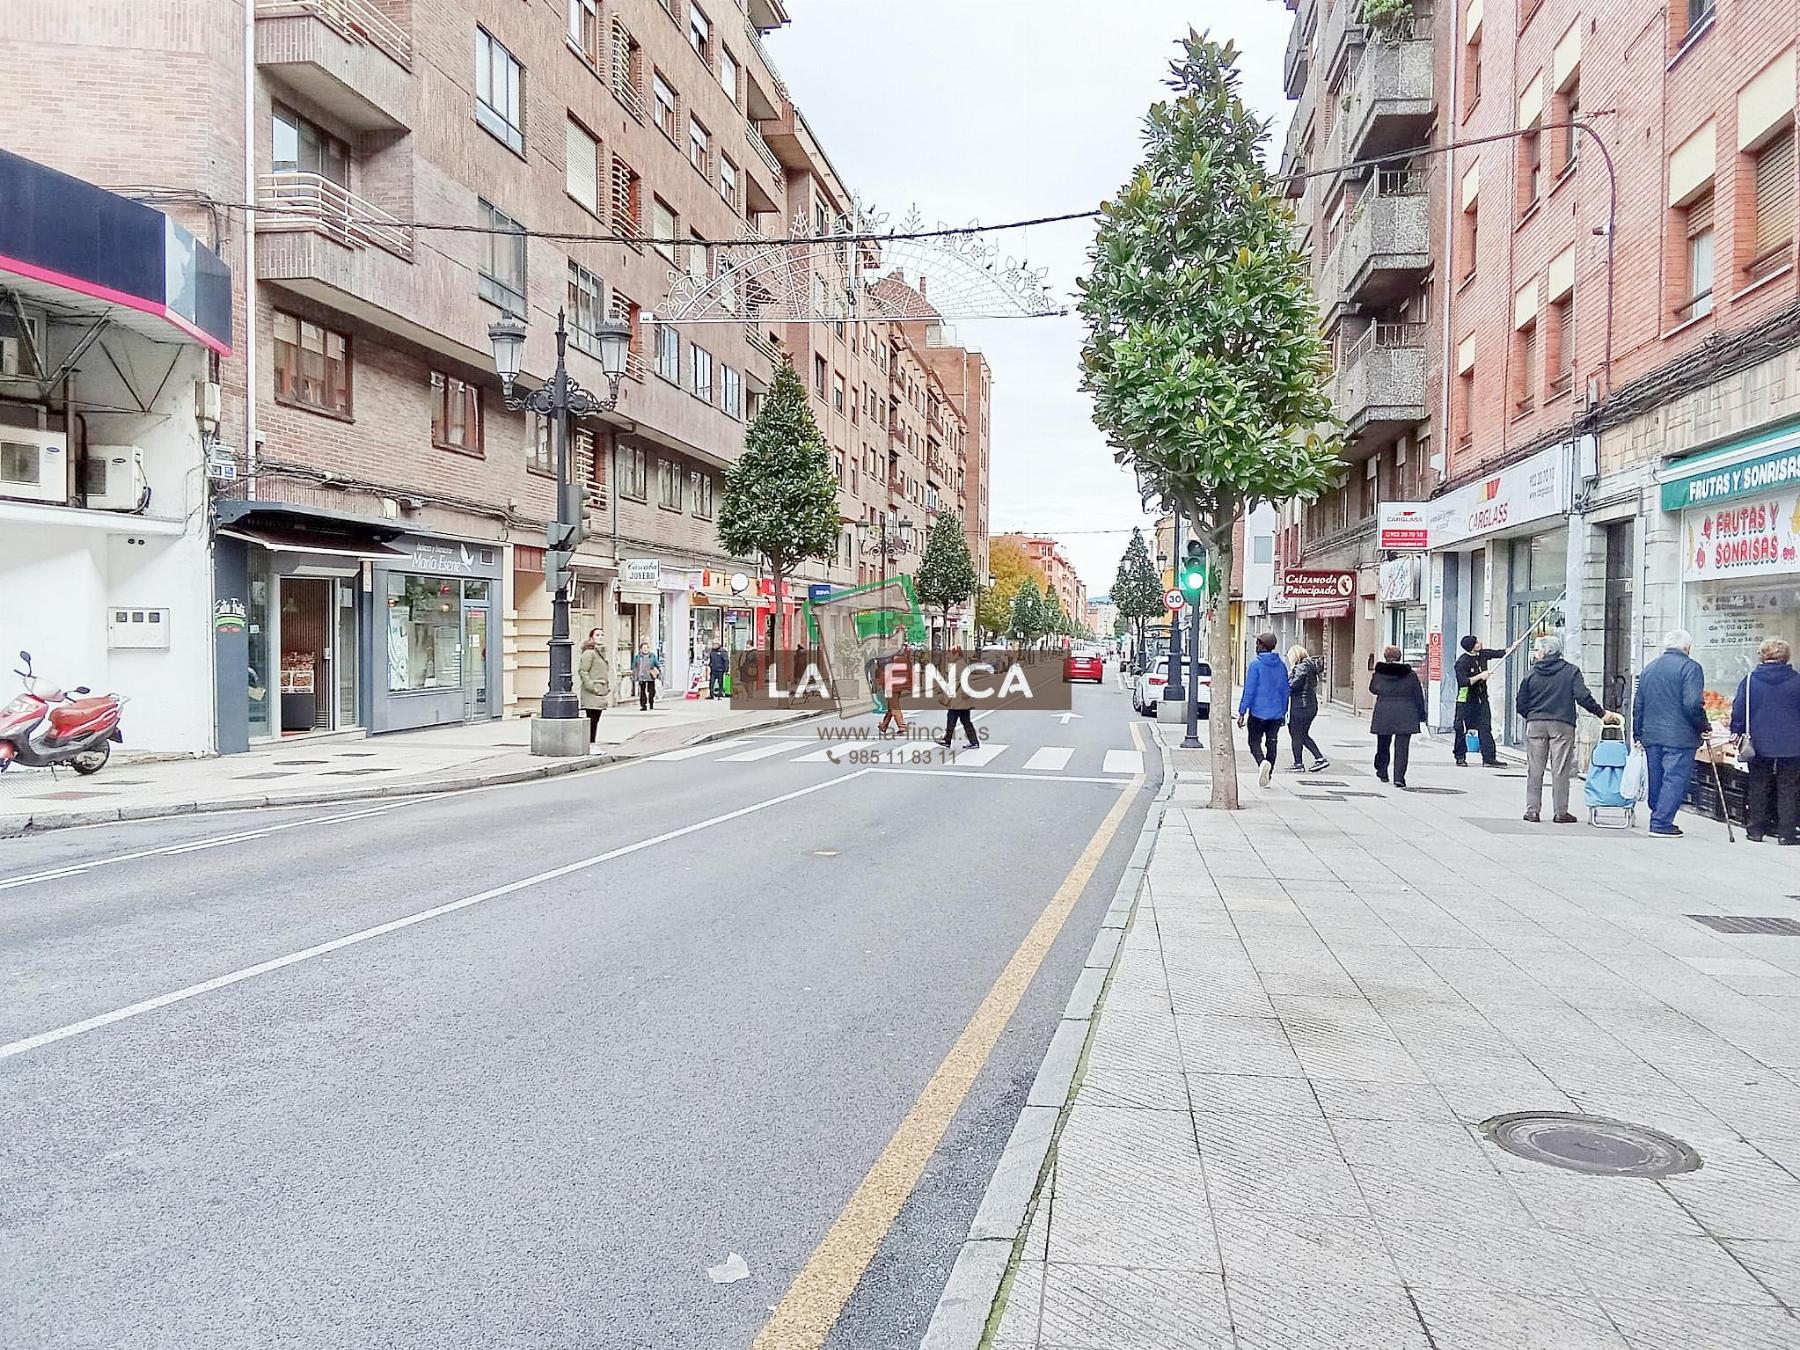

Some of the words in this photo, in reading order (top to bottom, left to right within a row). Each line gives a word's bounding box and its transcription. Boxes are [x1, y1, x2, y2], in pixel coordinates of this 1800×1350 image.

[1689, 472, 1731, 502] FRUTAS
[1732, 469, 1742, 492] Y
[1468, 502, 1509, 532] CARGLASS
[1715, 505, 1766, 538] FRUTAS
[1769, 501, 1780, 532] Y
[1715, 535, 1778, 569] SONRISAS
[629, 572, 655, 580] JOYERO
[1169, 595, 1182, 603] 30
